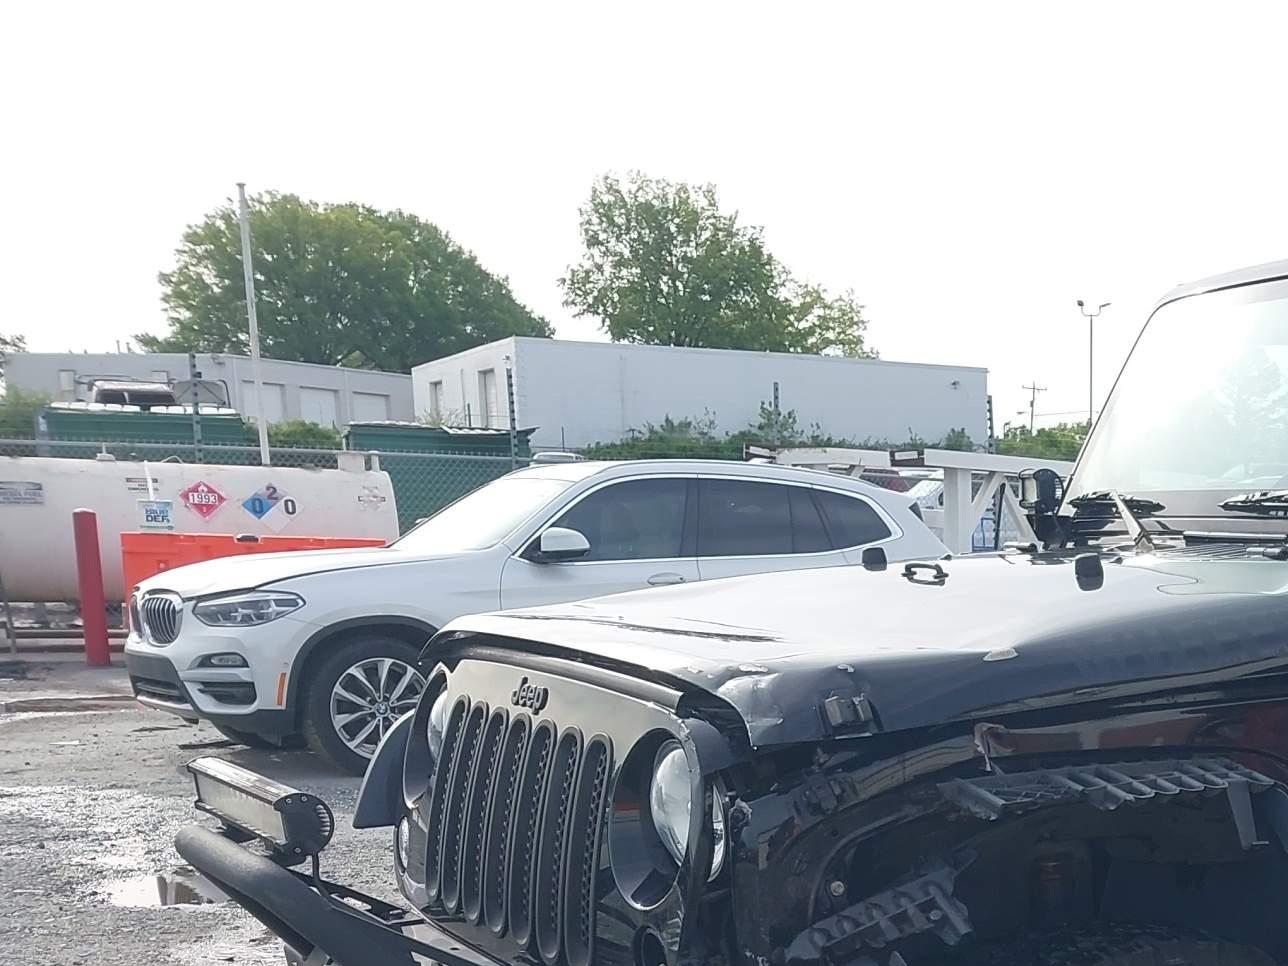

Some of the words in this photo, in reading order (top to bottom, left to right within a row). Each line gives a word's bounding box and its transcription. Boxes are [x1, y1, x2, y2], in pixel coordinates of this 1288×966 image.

[191, 493, 217, 504] 1993
[266, 486, 279, 500] 2
[251, 498, 263, 514] 0
[284, 499, 297, 515] 0
[511, 676, 549, 715] Jeep
